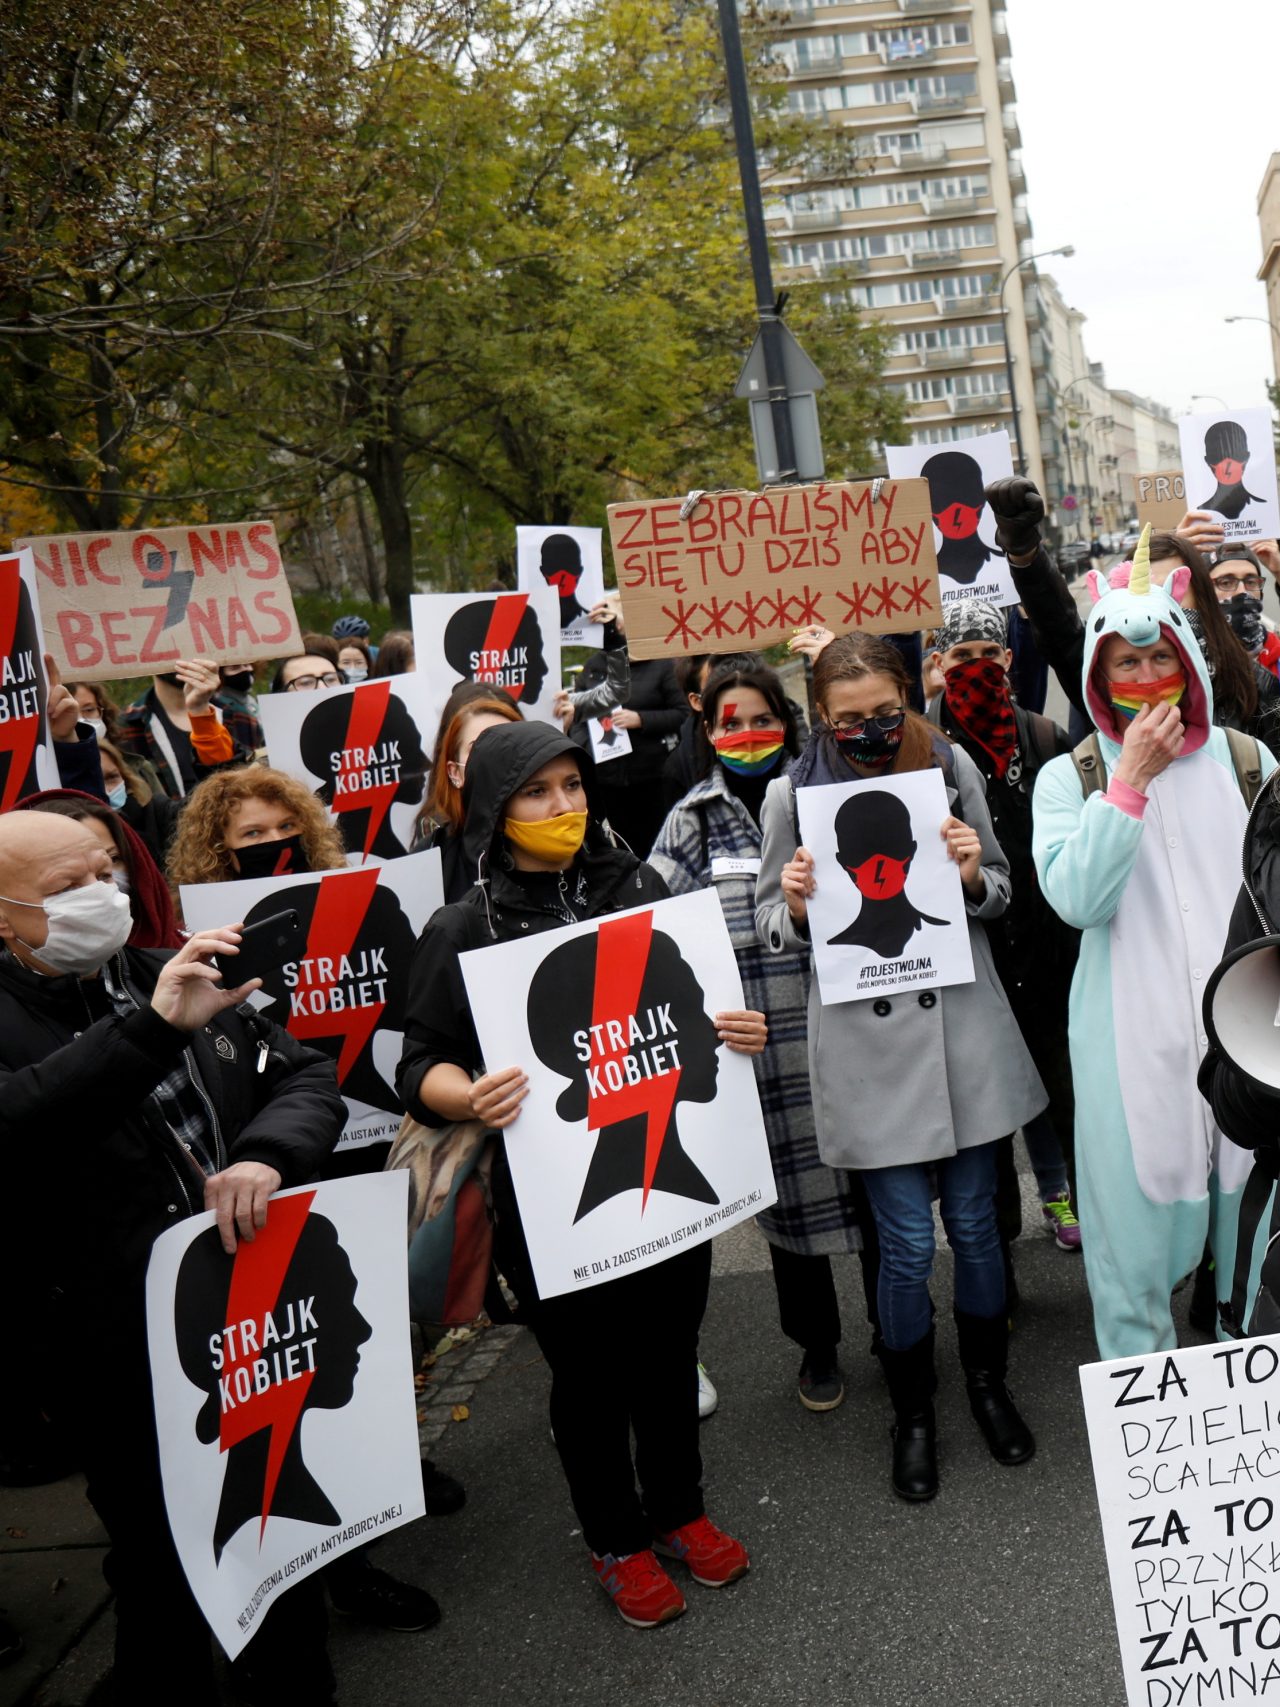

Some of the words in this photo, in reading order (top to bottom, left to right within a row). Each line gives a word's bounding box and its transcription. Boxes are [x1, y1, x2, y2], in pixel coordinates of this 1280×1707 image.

[615, 483, 898, 549] ZEBRALIŚMY
[21, 537, 121, 588] NIC
[132, 534, 173, 582] O
[188, 524, 280, 580] NAS
[623, 550, 688, 593] SIĘ
[686, 542, 745, 586] TU
[765, 529, 841, 574] DZIŚ
[861, 522, 926, 566] ABY
[942, 583, 1000, 600] #TOJESTWOJNA
[56, 604, 181, 668] BEZ
[186, 591, 292, 654] NAS
[469, 647, 529, 670] STRAJK
[472, 667, 527, 688] KOBIET
[329, 741, 402, 772] STRAJK
[335, 764, 401, 795] KOBIET
[282, 947, 389, 987] STRAJK
[860, 957, 932, 979] #TOJESTWOJNA
[898, 973, 918, 984] STRAJK
[918, 970, 938, 980] KOBIET
[290, 978, 388, 1018] KOBIET
[572, 1003, 679, 1062] STRAJK
[585, 1040, 682, 1099] KOBIET
[351, 1126, 385, 1141] USTAWY
[573, 1265, 591, 1280] NIE
[592, 1258, 612, 1275] DLA
[612, 1236, 671, 1267] ZAOSTRZENIA
[671, 1219, 703, 1245] USTAWY
[704, 1189, 762, 1229] ANTYABORCYJNEJ
[209, 1295, 319, 1371] STRAJK
[218, 1337, 318, 1414] KOBIET
[1109, 1357, 1188, 1407] ZA
[1213, 1344, 1279, 1388] TO
[1128, 1509, 1190, 1549] ZA
[1214, 1497, 1274, 1536] TO
[236, 1612, 250, 1631] NIE
[284, 1545, 318, 1578] USTAWY
[320, 1503, 403, 1556] ANTYABORCYJNEJ
[1136, 1581, 1269, 1632] TYLKO
[1139, 1627, 1208, 1671] ZA
